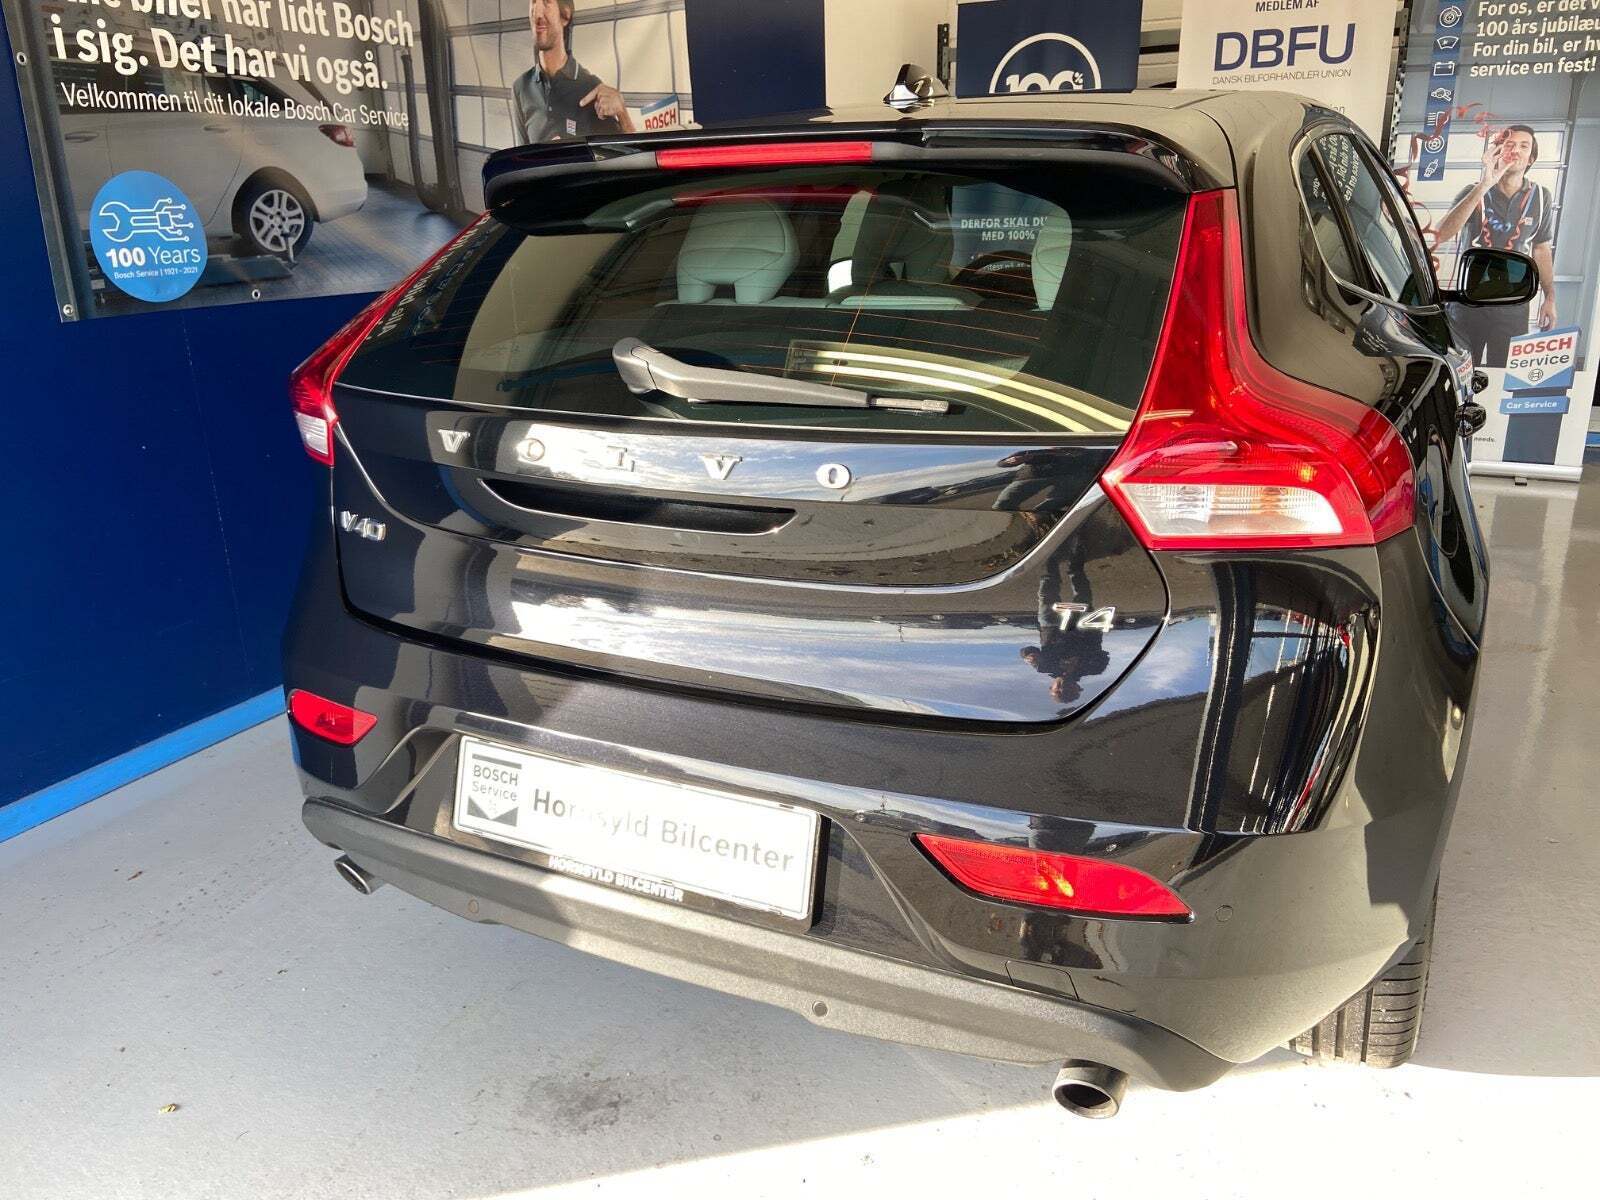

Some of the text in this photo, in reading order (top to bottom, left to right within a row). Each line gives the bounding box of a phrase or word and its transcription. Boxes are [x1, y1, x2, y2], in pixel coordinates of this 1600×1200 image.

[1255, 0, 1303, 13] MEDLEM
[1478, 1, 1506, 17] For
[1508, 2, 1533, 16] os,
[1537, 0, 1556, 13] er
[1558, 0, 1587, 12] det
[221, 0, 271, 29] har
[278, 0, 330, 37] lidt
[332, 2, 414, 47] Bosch
[1476, 20, 1509, 37] 100
[1511, 18, 1538, 35] års
[50, 13, 388, 95] i sig. Det har vi også.
[1214, 22, 1356, 72] DBFU
[1473, 42, 1500, 57] For
[1503, 40, 1529, 56] din
[1533, 37, 1558, 56] bil,
[1563, 39, 1582, 53] er
[1212, 68, 1352, 85] DANSK BILFORHANDLER UNION
[1469, 55, 1598, 77] service en fest!
[60, 81, 409, 127] Velkommen til dit lokale Bosch Car Service
[960, 218, 1001, 229] DERFOR
[1002, 216, 1030, 228] SKAL
[981, 229, 1035, 241] MED 100%
[106, 246, 201, 268] 100 Years
[114, 271, 135, 279] Bosch
[1511, 336, 1573, 357] BOSCH
[1509, 354, 1570, 369] Service
[1524, 401, 1558, 409] Service
[438, 428, 852, 490] VOLVO
[340, 510, 386, 541] V40
[1052, 602, 1116, 633] T4
[473, 764, 519, 787] BOSCH
[472, 780, 518, 802] Service
[661, 818, 795, 874] Bilcenter
[615, 873, 684, 902] BILCENTER
